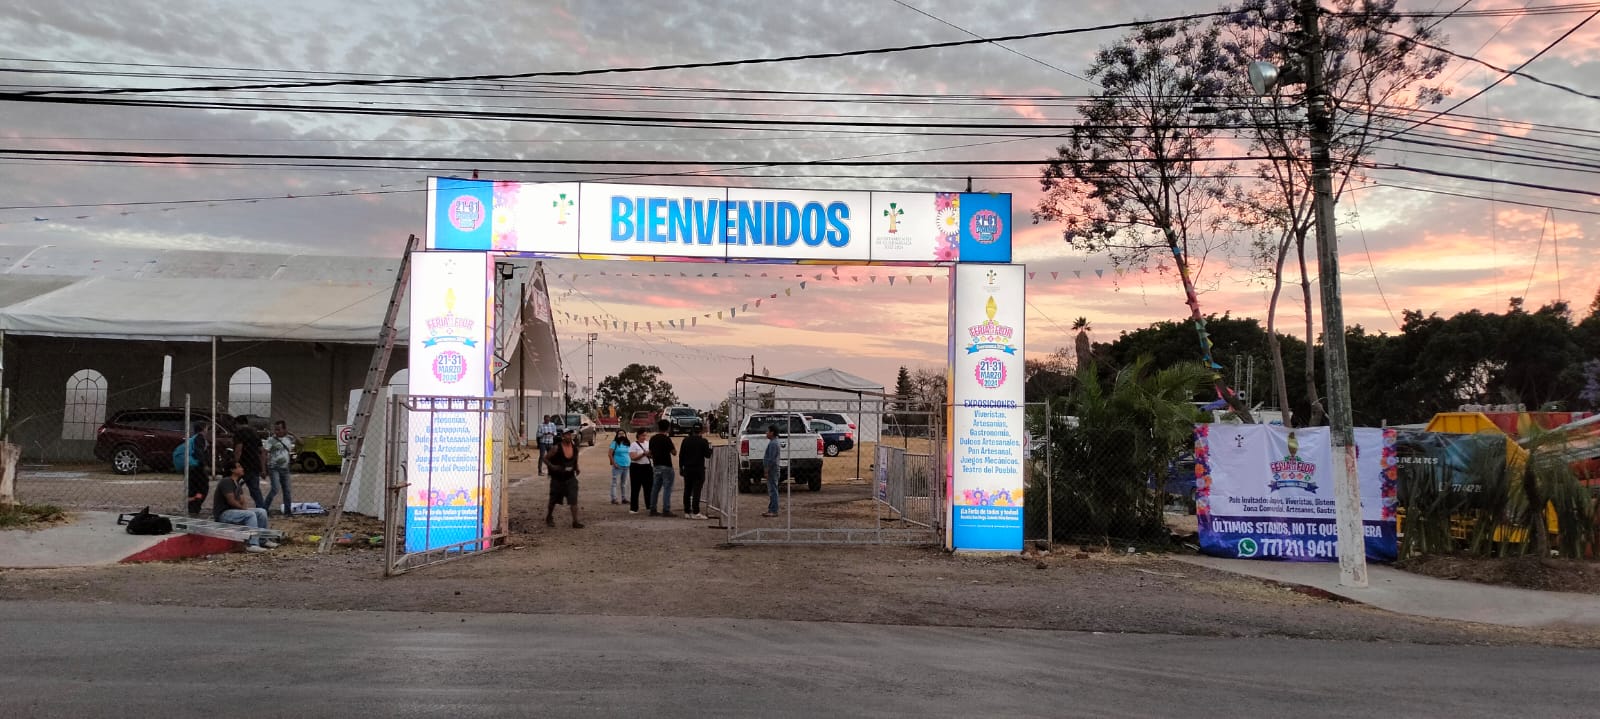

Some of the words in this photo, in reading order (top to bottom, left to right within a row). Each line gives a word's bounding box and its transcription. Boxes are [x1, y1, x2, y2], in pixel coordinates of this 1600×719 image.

[610, 195, 851, 248] BIENVENIDOS
[438, 354, 462, 366] 21-31
[438, 365, 462, 374] MARZO
[980, 361, 1002, 372] 21-31
[980, 371, 1002, 380] MARZO
[968, 446, 980, 455] Pan
[960, 456, 983, 466] Juegos
[983, 465, 995, 474] del
[1270, 461, 1291, 474] FERIA
[1296, 461, 1316, 476] FLOR
[1315, 498, 1337, 507] Sistem
[1243, 504, 1258, 513] Zona
[1212, 517, 1253, 534] ÚLTIMOS
[1255, 520, 1291, 536] STANDS,
[1292, 522, 1305, 535] NO
[1306, 523, 1318, 535] TE
[1319, 523, 1338, 537] QUE
[1285, 538, 1305, 557] 211
